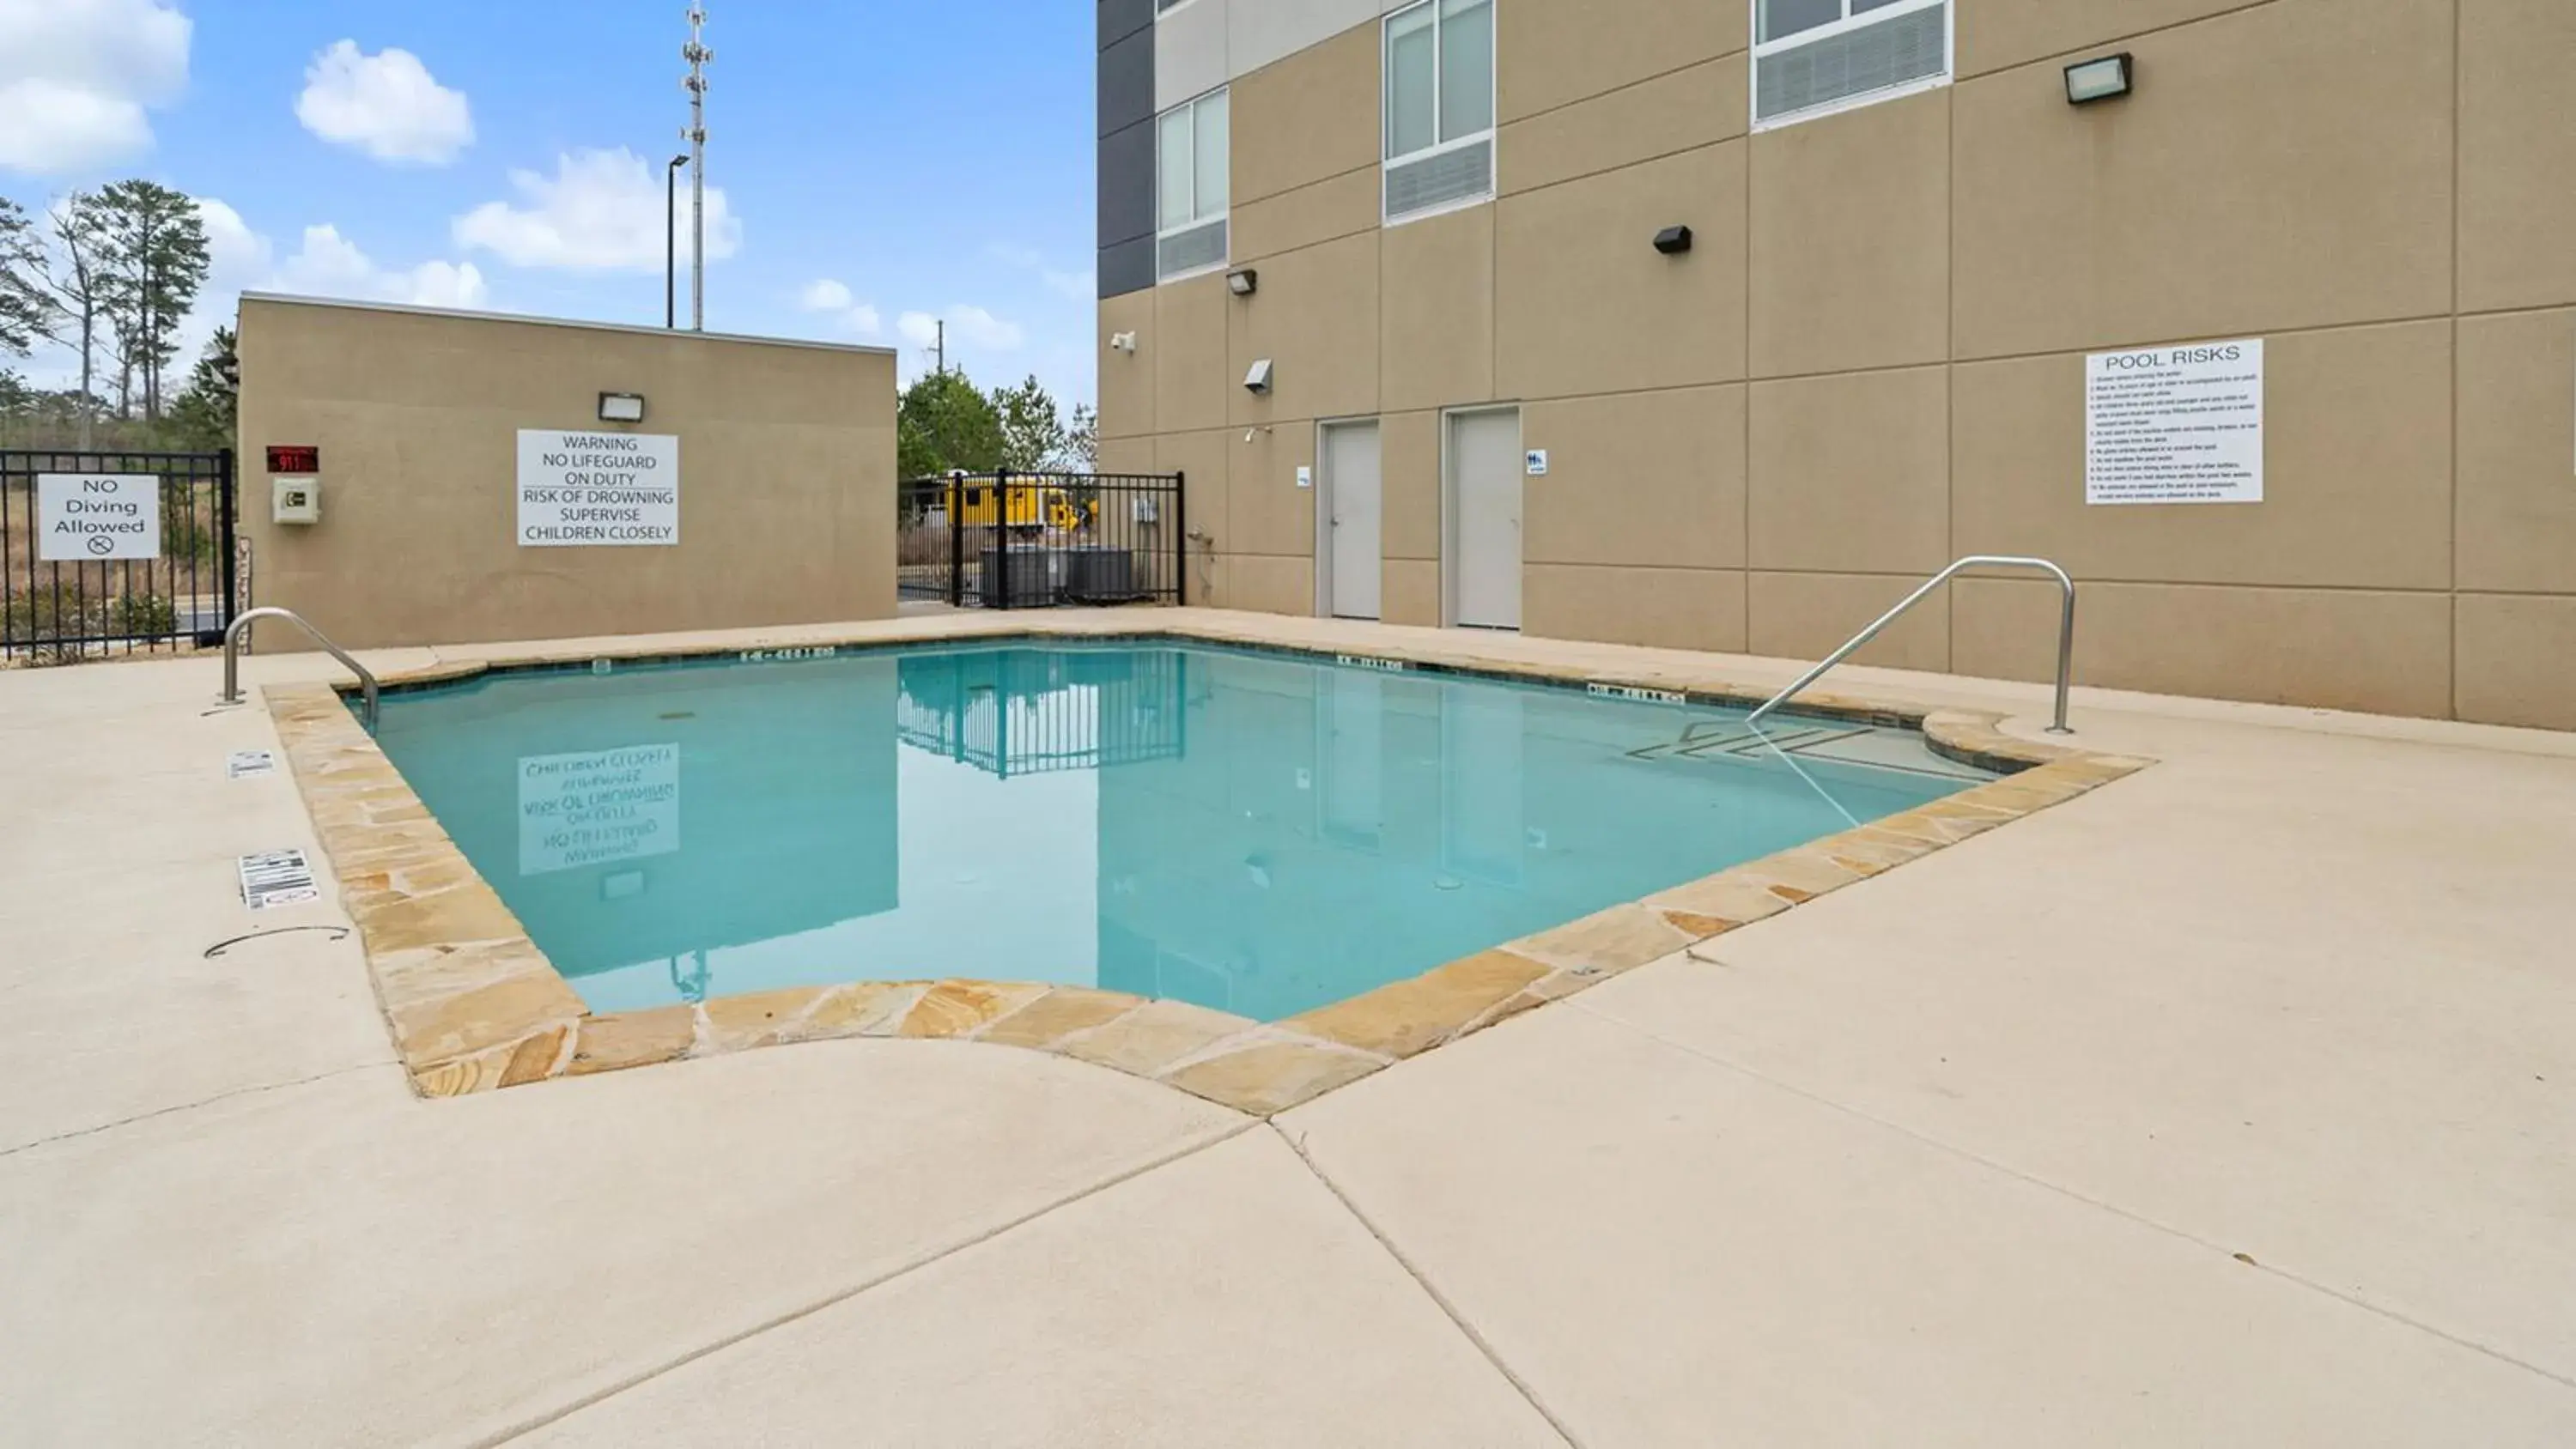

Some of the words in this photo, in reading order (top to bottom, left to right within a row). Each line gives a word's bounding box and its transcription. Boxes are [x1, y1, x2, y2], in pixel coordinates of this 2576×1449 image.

[2105, 354, 2166, 371] POOL
[2172, 346, 2240, 365] RISKS
[563, 436, 638, 451] WARNING
[279, 455, 300, 471] 911
[543, 453, 568, 468] NO
[572, 455, 657, 469] LIFEGUARD
[565, 472, 589, 485] ON
[594, 472, 636, 486] DUTY
[83, 480, 118, 494] NO
[524, 489, 558, 503] RISK
[562, 490, 583, 503] OF
[587, 491, 674, 505] DROWNING
[66, 500, 138, 516] Diving
[560, 508, 641, 521] SUPERVISE
[54, 519, 145, 533] Allowed
[526, 526, 605, 540] CHILDREN
[610, 526, 671, 539] CLOSELY
